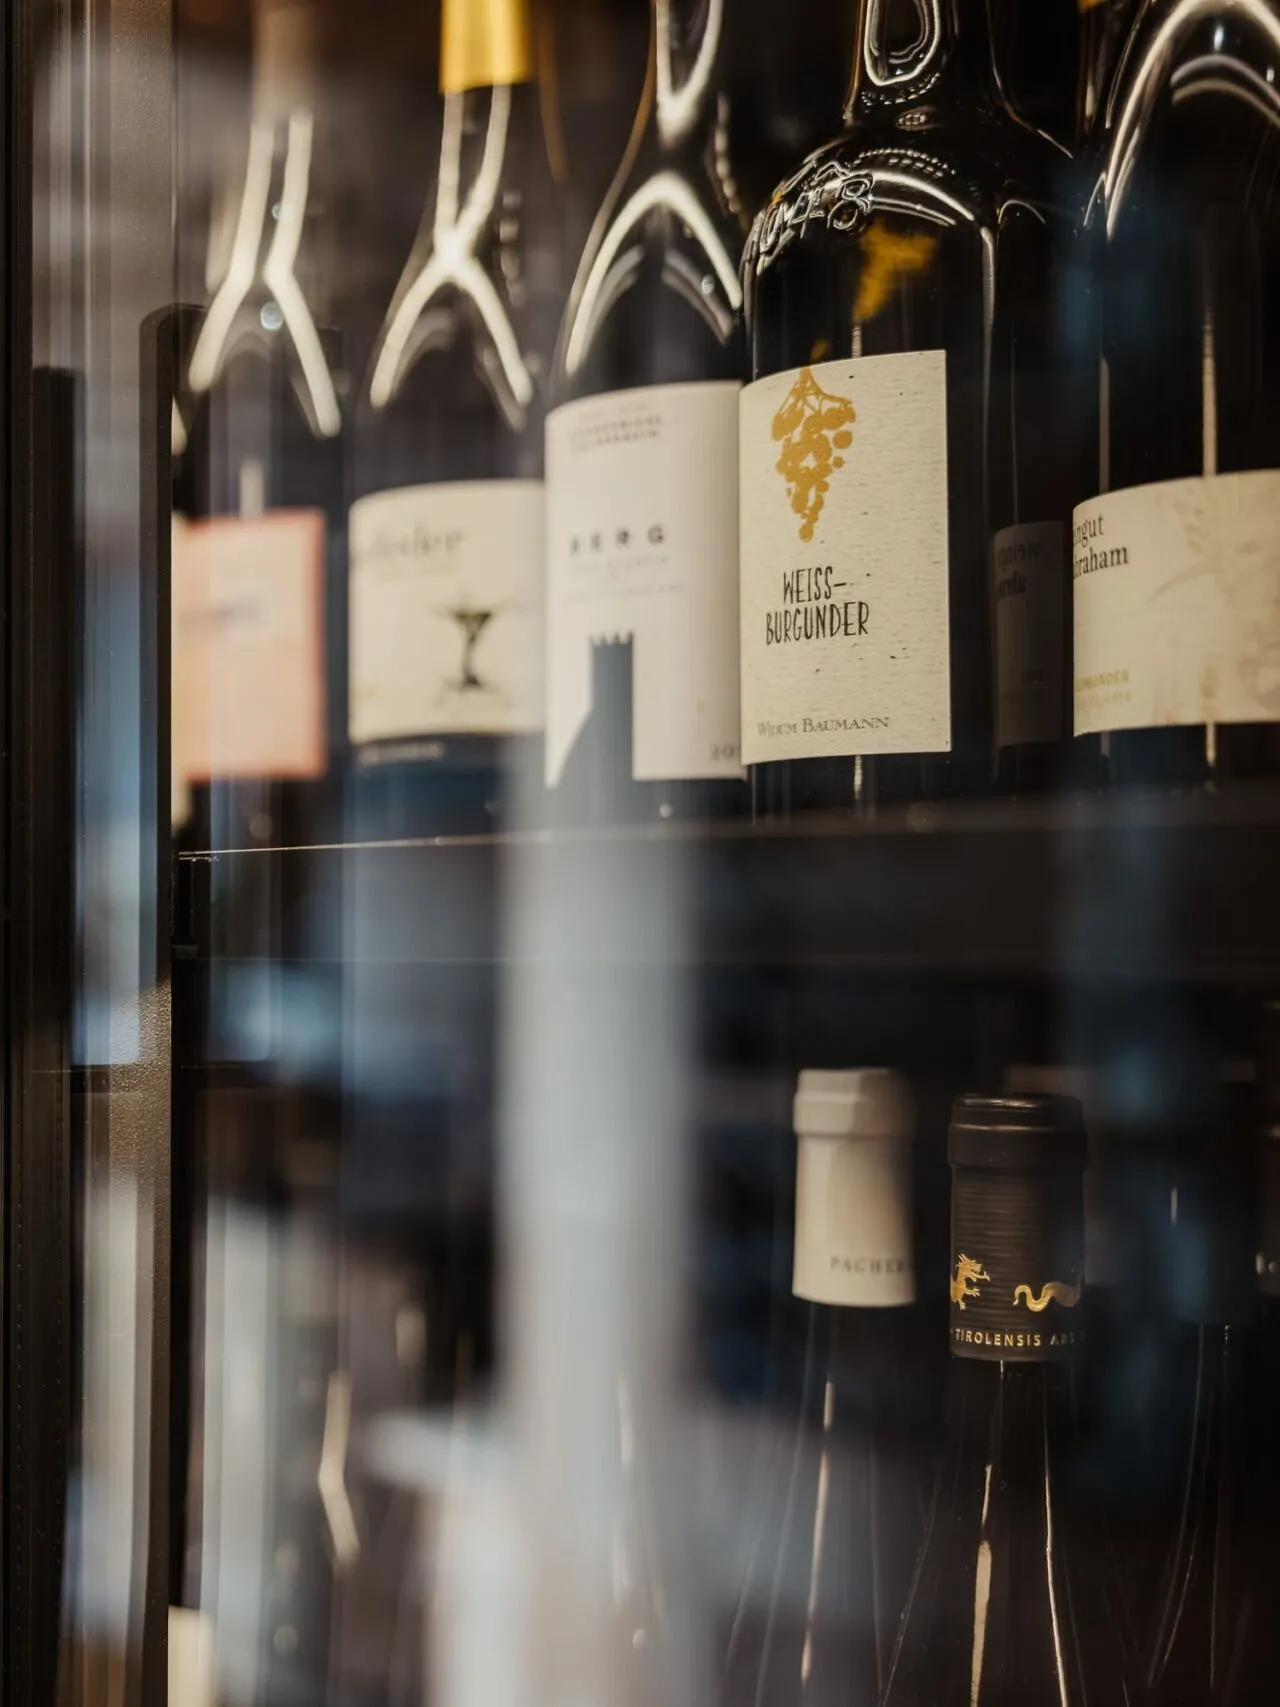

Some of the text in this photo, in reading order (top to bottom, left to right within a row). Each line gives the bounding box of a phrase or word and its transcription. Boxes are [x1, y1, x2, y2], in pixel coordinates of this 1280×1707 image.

[570, 523, 664, 555] BERG
[783, 566, 847, 604] WEISS-
[766, 601, 869, 645] BURGUNDER
[802, 717, 889, 733] BAUMANN
[955, 1328, 1041, 1347] TIROLENSIS
